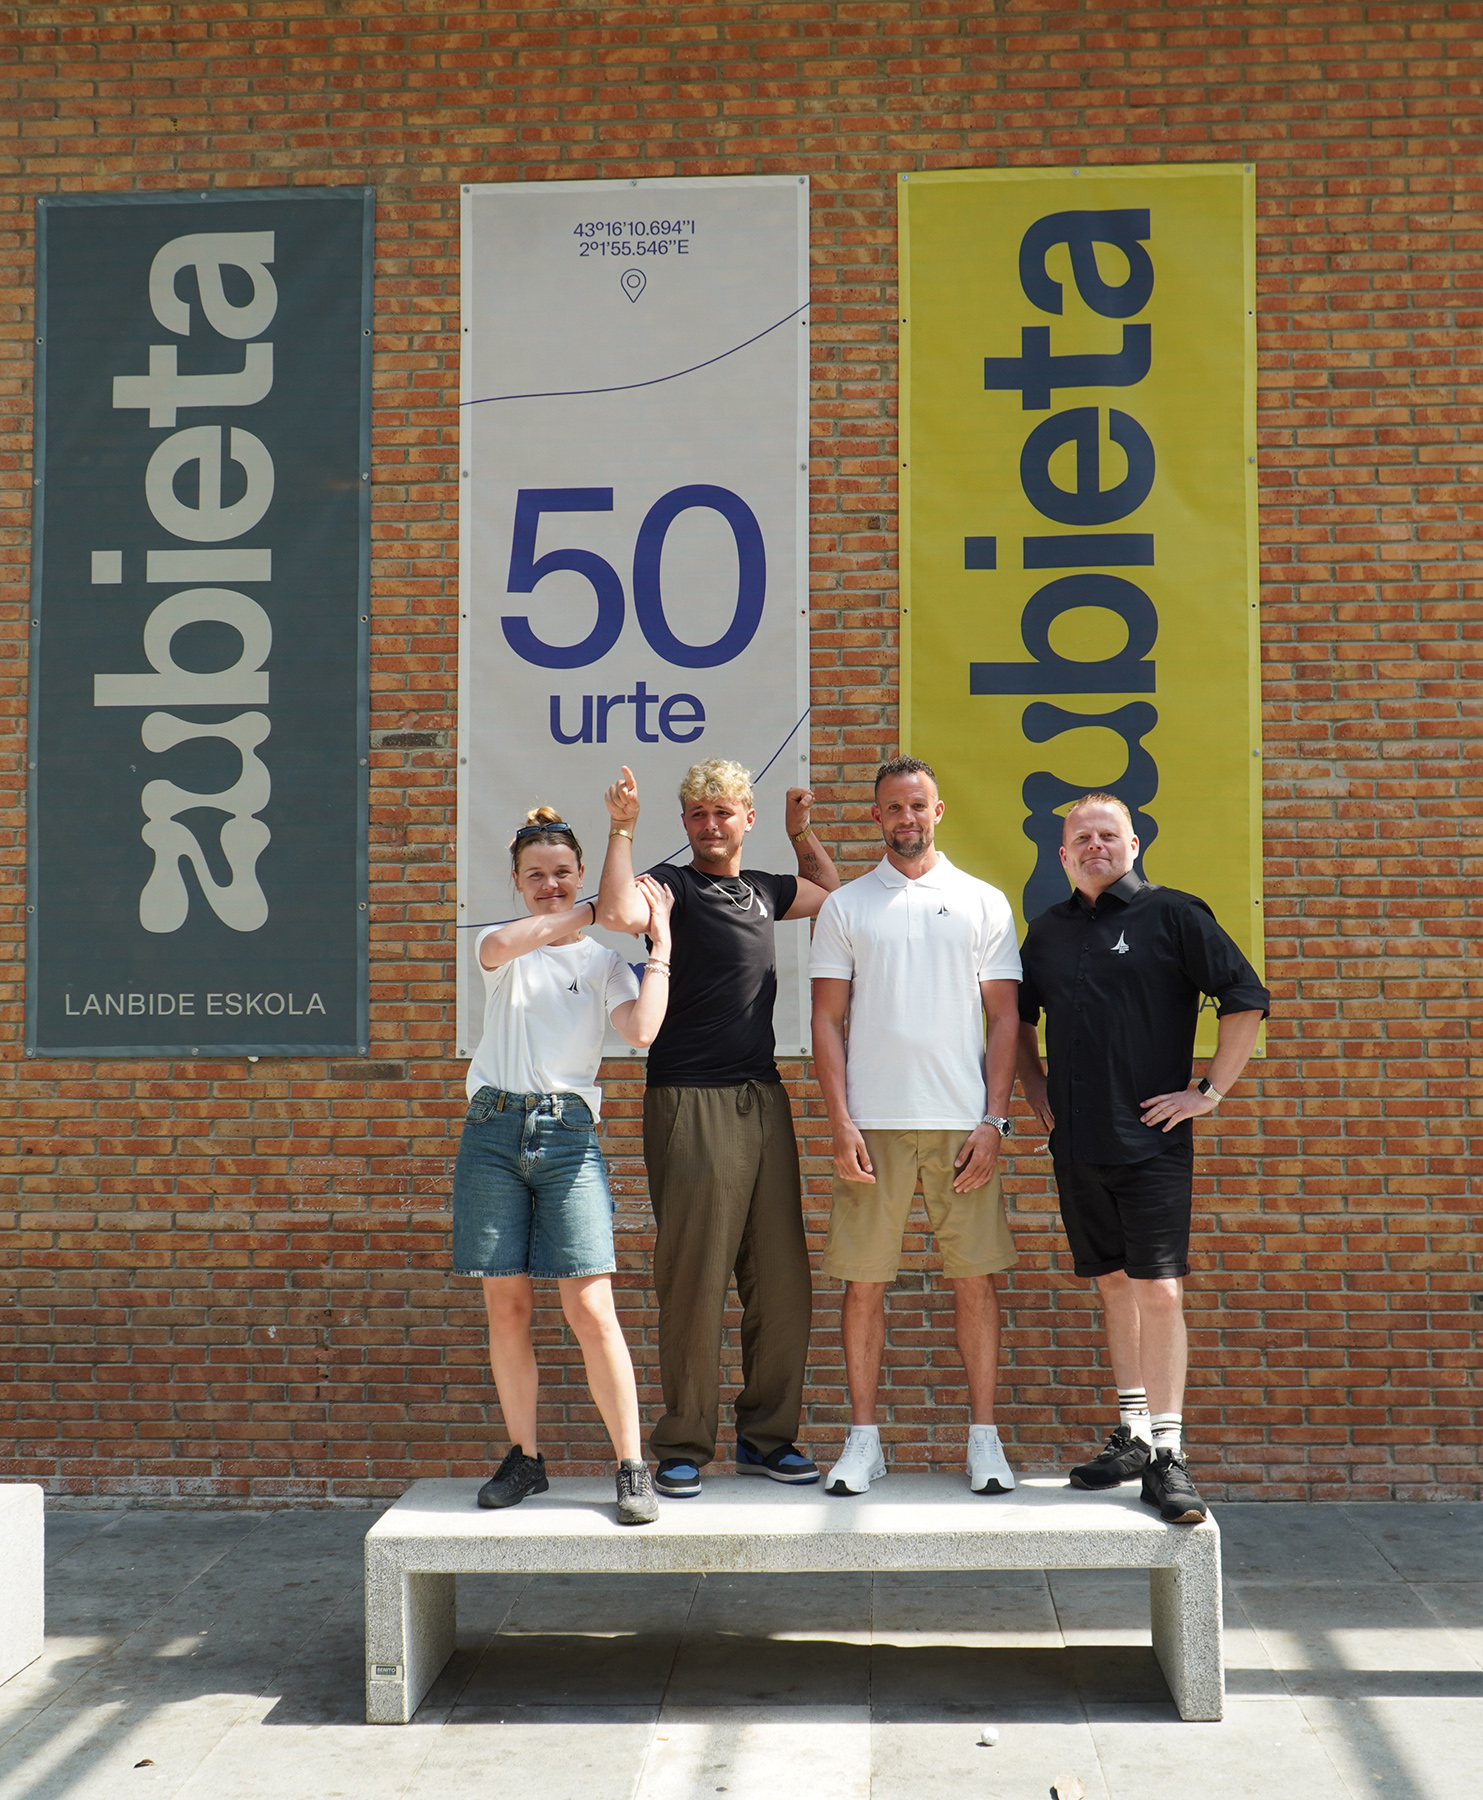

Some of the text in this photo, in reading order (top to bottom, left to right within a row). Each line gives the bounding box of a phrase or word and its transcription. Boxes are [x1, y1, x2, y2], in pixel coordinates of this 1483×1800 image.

[91, 231, 278, 933] zubieta
[501, 484, 766, 669] 50
[550, 681, 706, 744] urte
[65, 993, 326, 1016] LANBIDE ESKOLA
